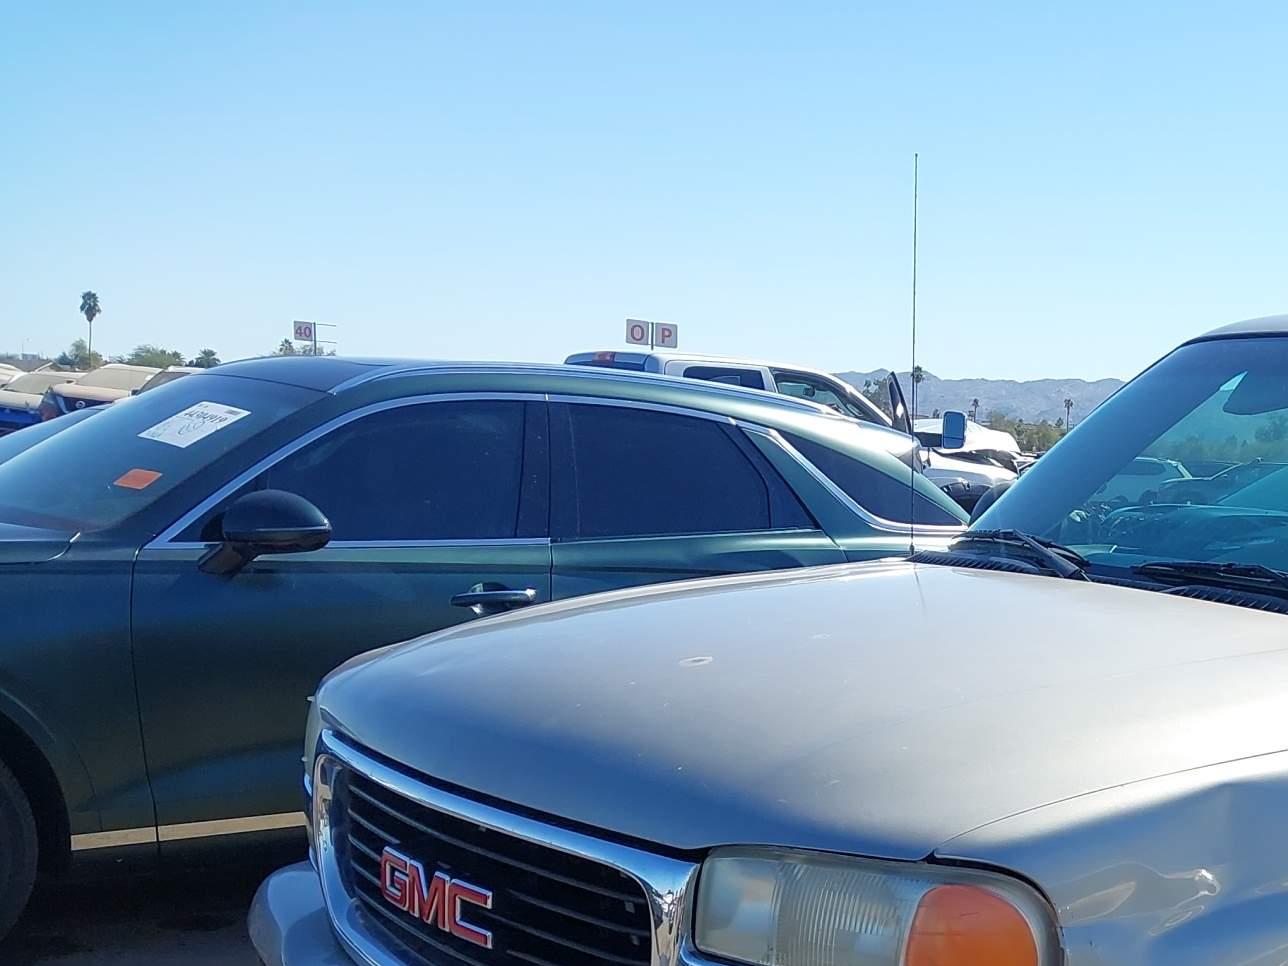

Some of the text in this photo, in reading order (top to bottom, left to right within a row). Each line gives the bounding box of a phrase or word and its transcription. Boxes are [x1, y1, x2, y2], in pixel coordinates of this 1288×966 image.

[295, 326, 312, 337] 40
[661, 327, 673, 344] P
[382, 846, 493, 949] GMC
